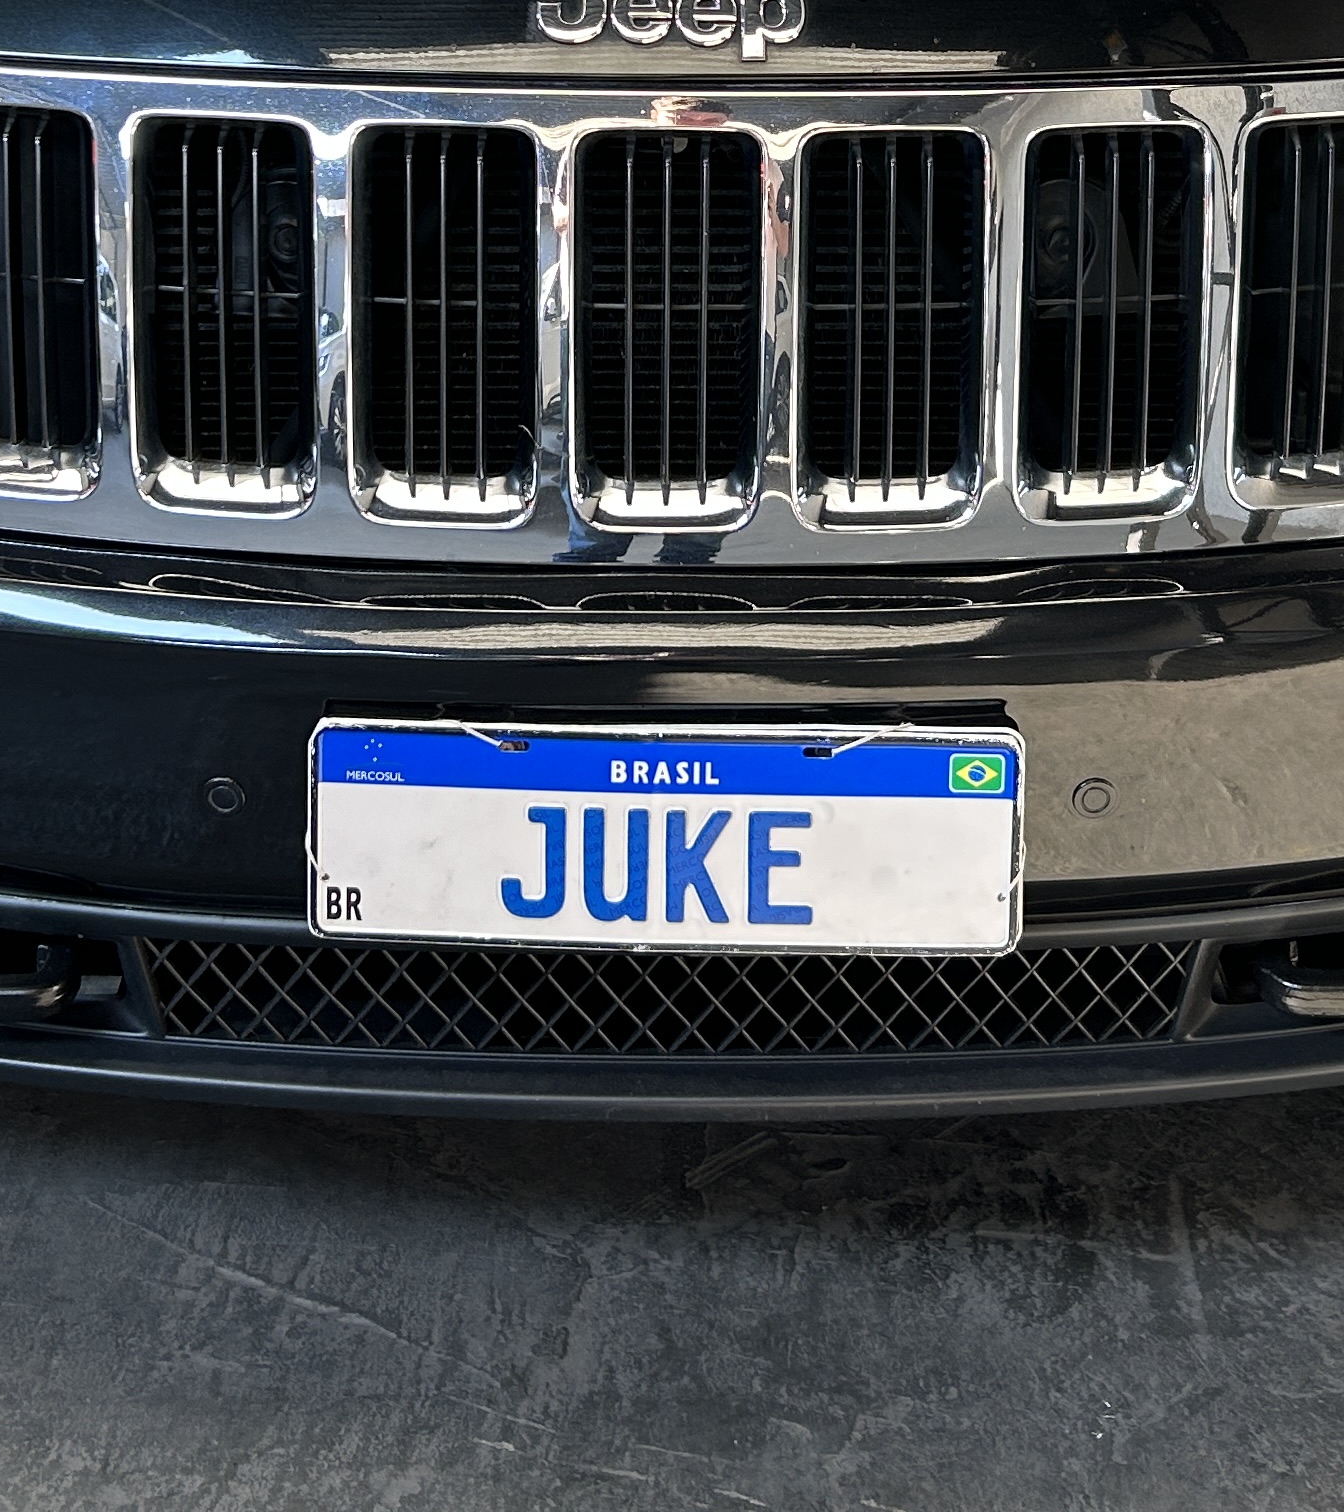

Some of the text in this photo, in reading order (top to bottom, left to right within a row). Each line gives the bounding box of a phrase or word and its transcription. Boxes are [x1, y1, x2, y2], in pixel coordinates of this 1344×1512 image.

[346, 759, 720, 785] MERCOSUL BRASIL
[499, 806, 813, 926] JUKE
[326, 886, 362, 921] BR
